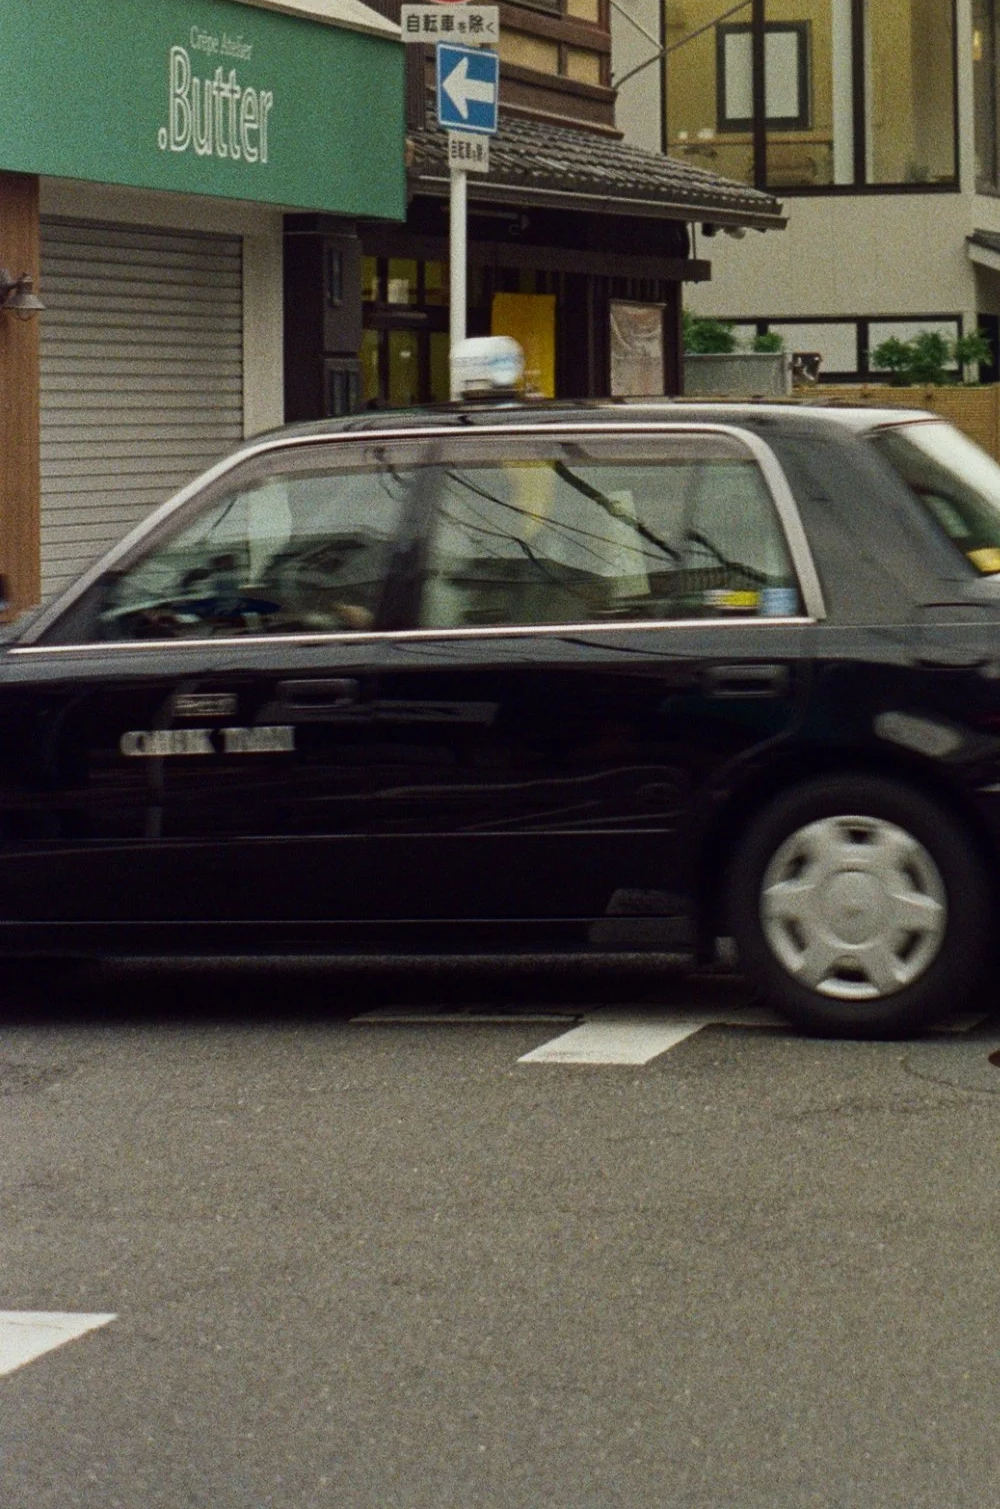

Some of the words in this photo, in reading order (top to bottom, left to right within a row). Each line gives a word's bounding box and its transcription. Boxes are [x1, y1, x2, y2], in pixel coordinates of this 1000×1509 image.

[406, 14, 496, 35] 自転車を除く
